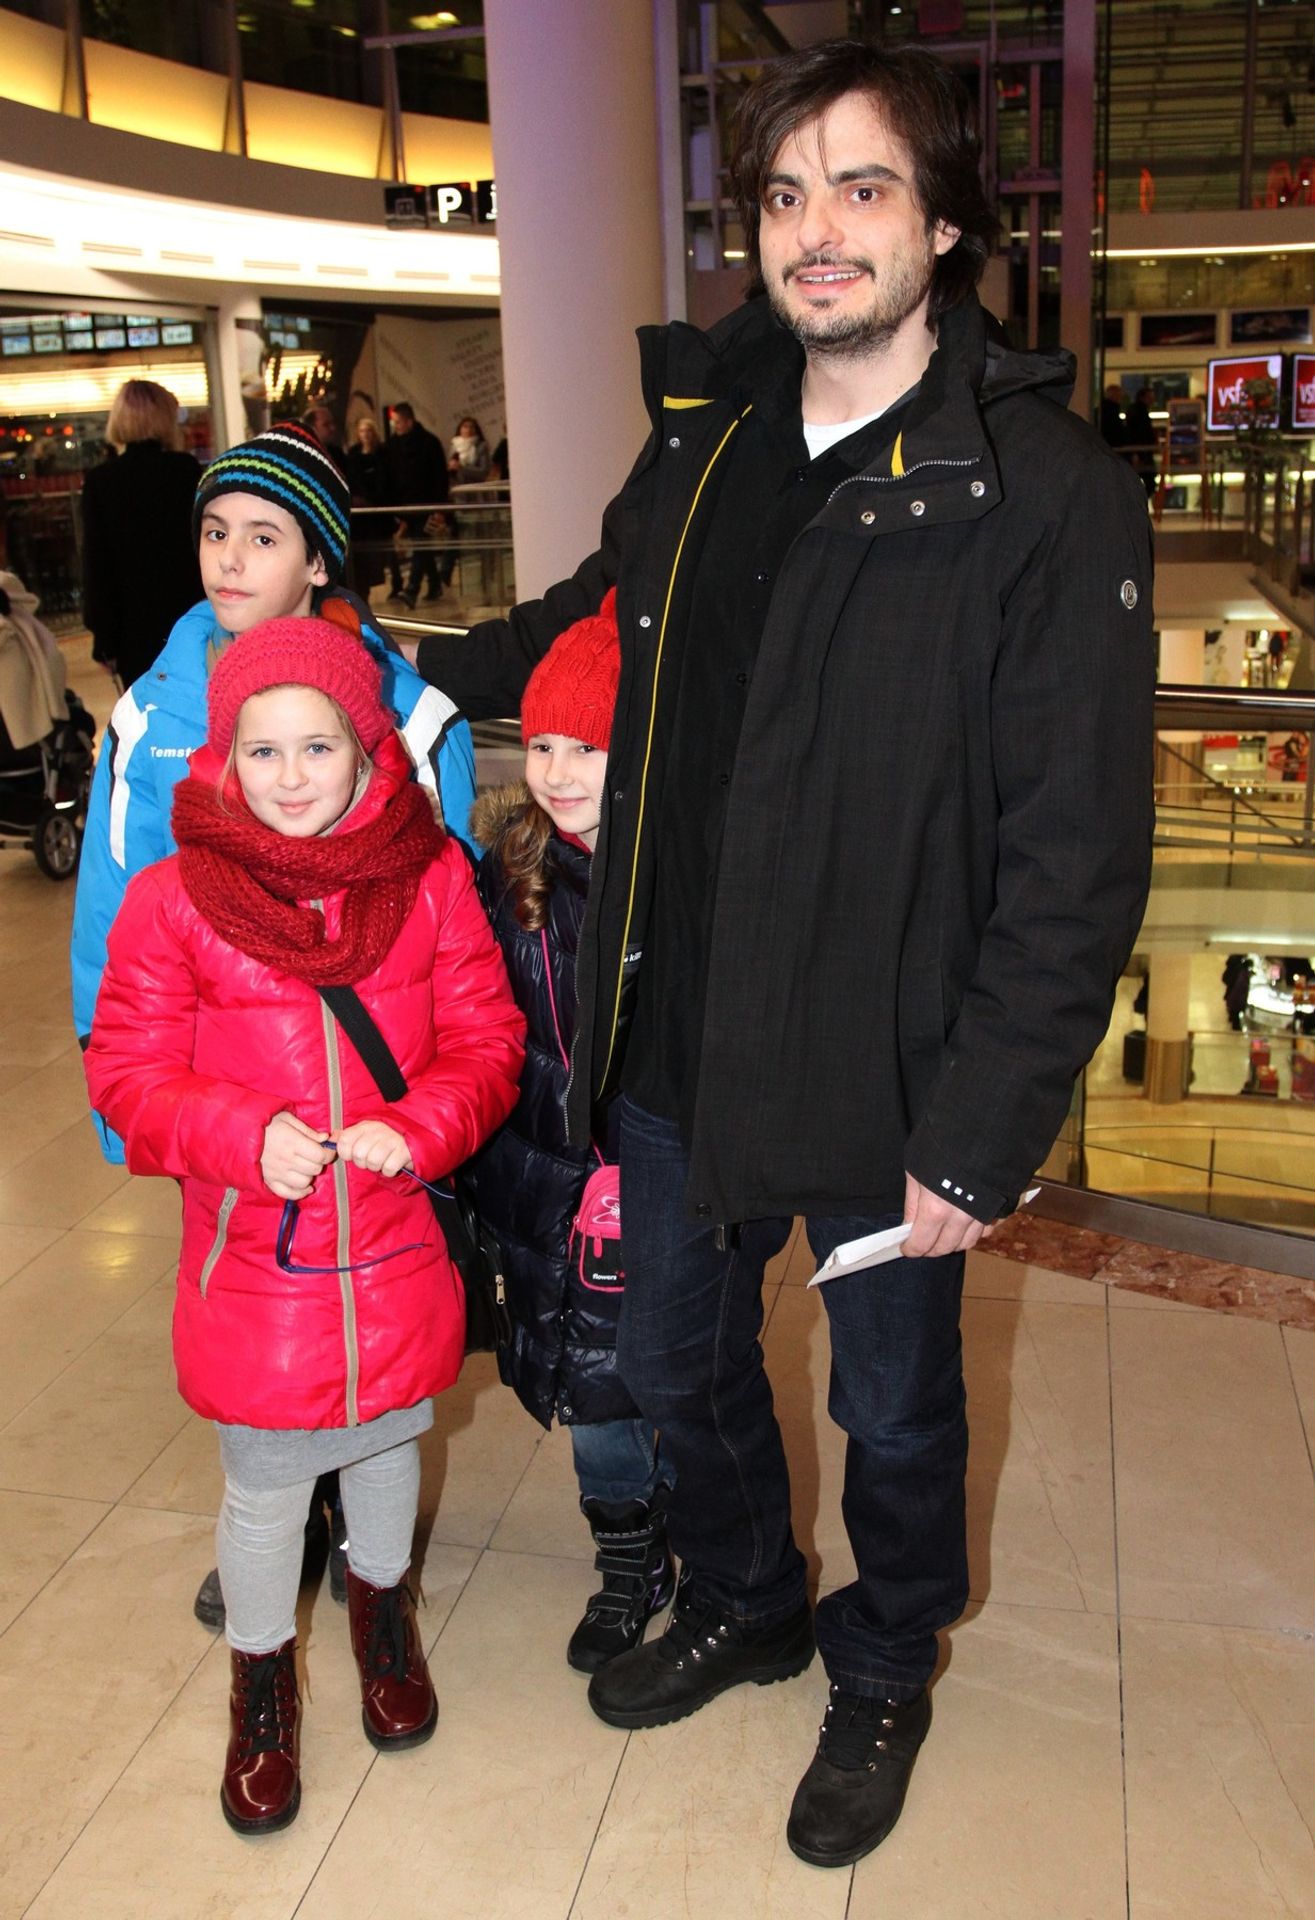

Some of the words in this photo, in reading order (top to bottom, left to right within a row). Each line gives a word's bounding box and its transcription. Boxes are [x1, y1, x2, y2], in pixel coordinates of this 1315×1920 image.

[437, 187, 463, 224] P
[149, 746, 197, 758] Temst
[592, 1272, 618, 1281] flowers
